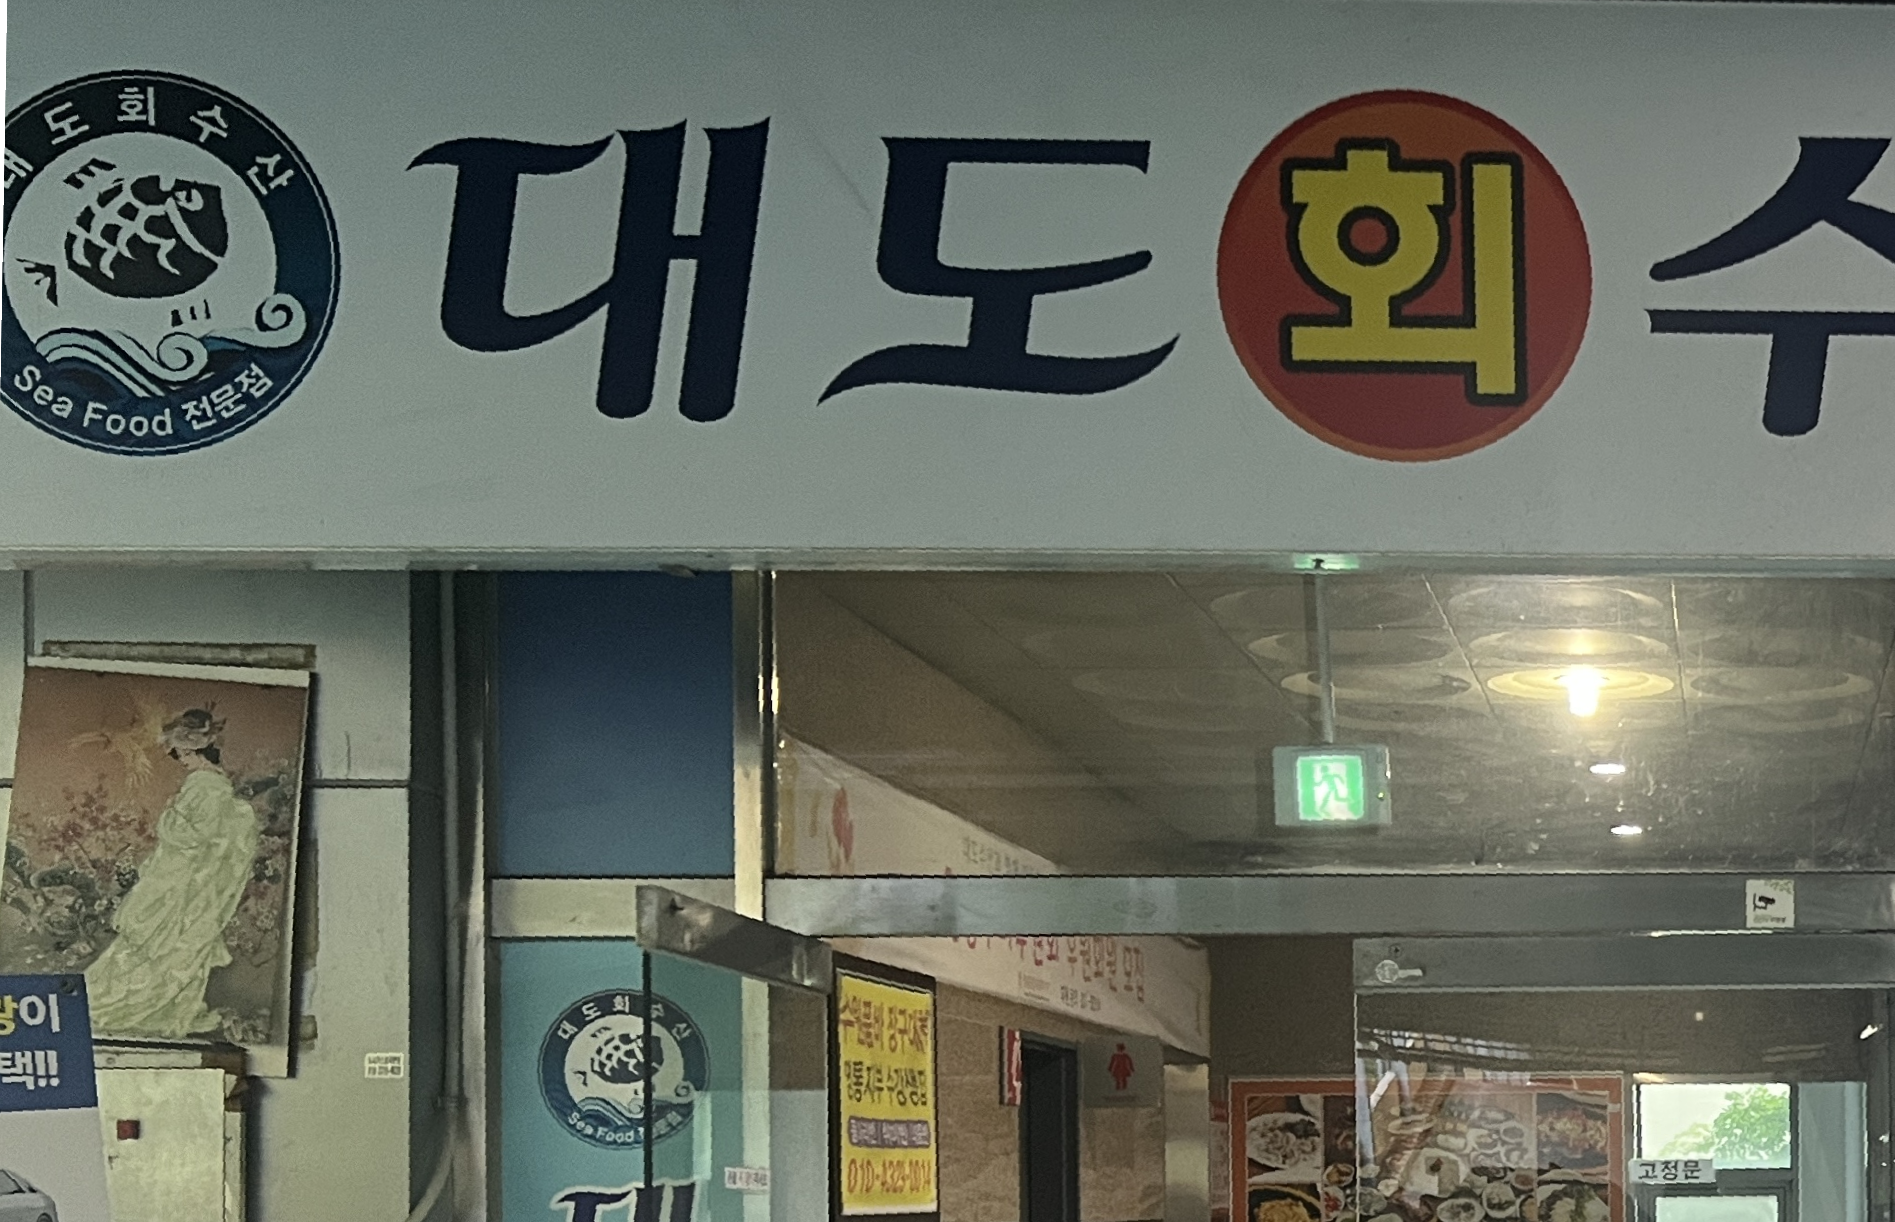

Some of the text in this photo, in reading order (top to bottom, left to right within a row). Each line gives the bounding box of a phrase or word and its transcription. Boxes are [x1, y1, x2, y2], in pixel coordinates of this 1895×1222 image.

[14, 363, 273, 436] Sea Food 전문점
[568, 1112, 593, 1135] Sea
[596, 1127, 634, 1142] Food
[1638, 1160, 1702, 1181] 고정문
